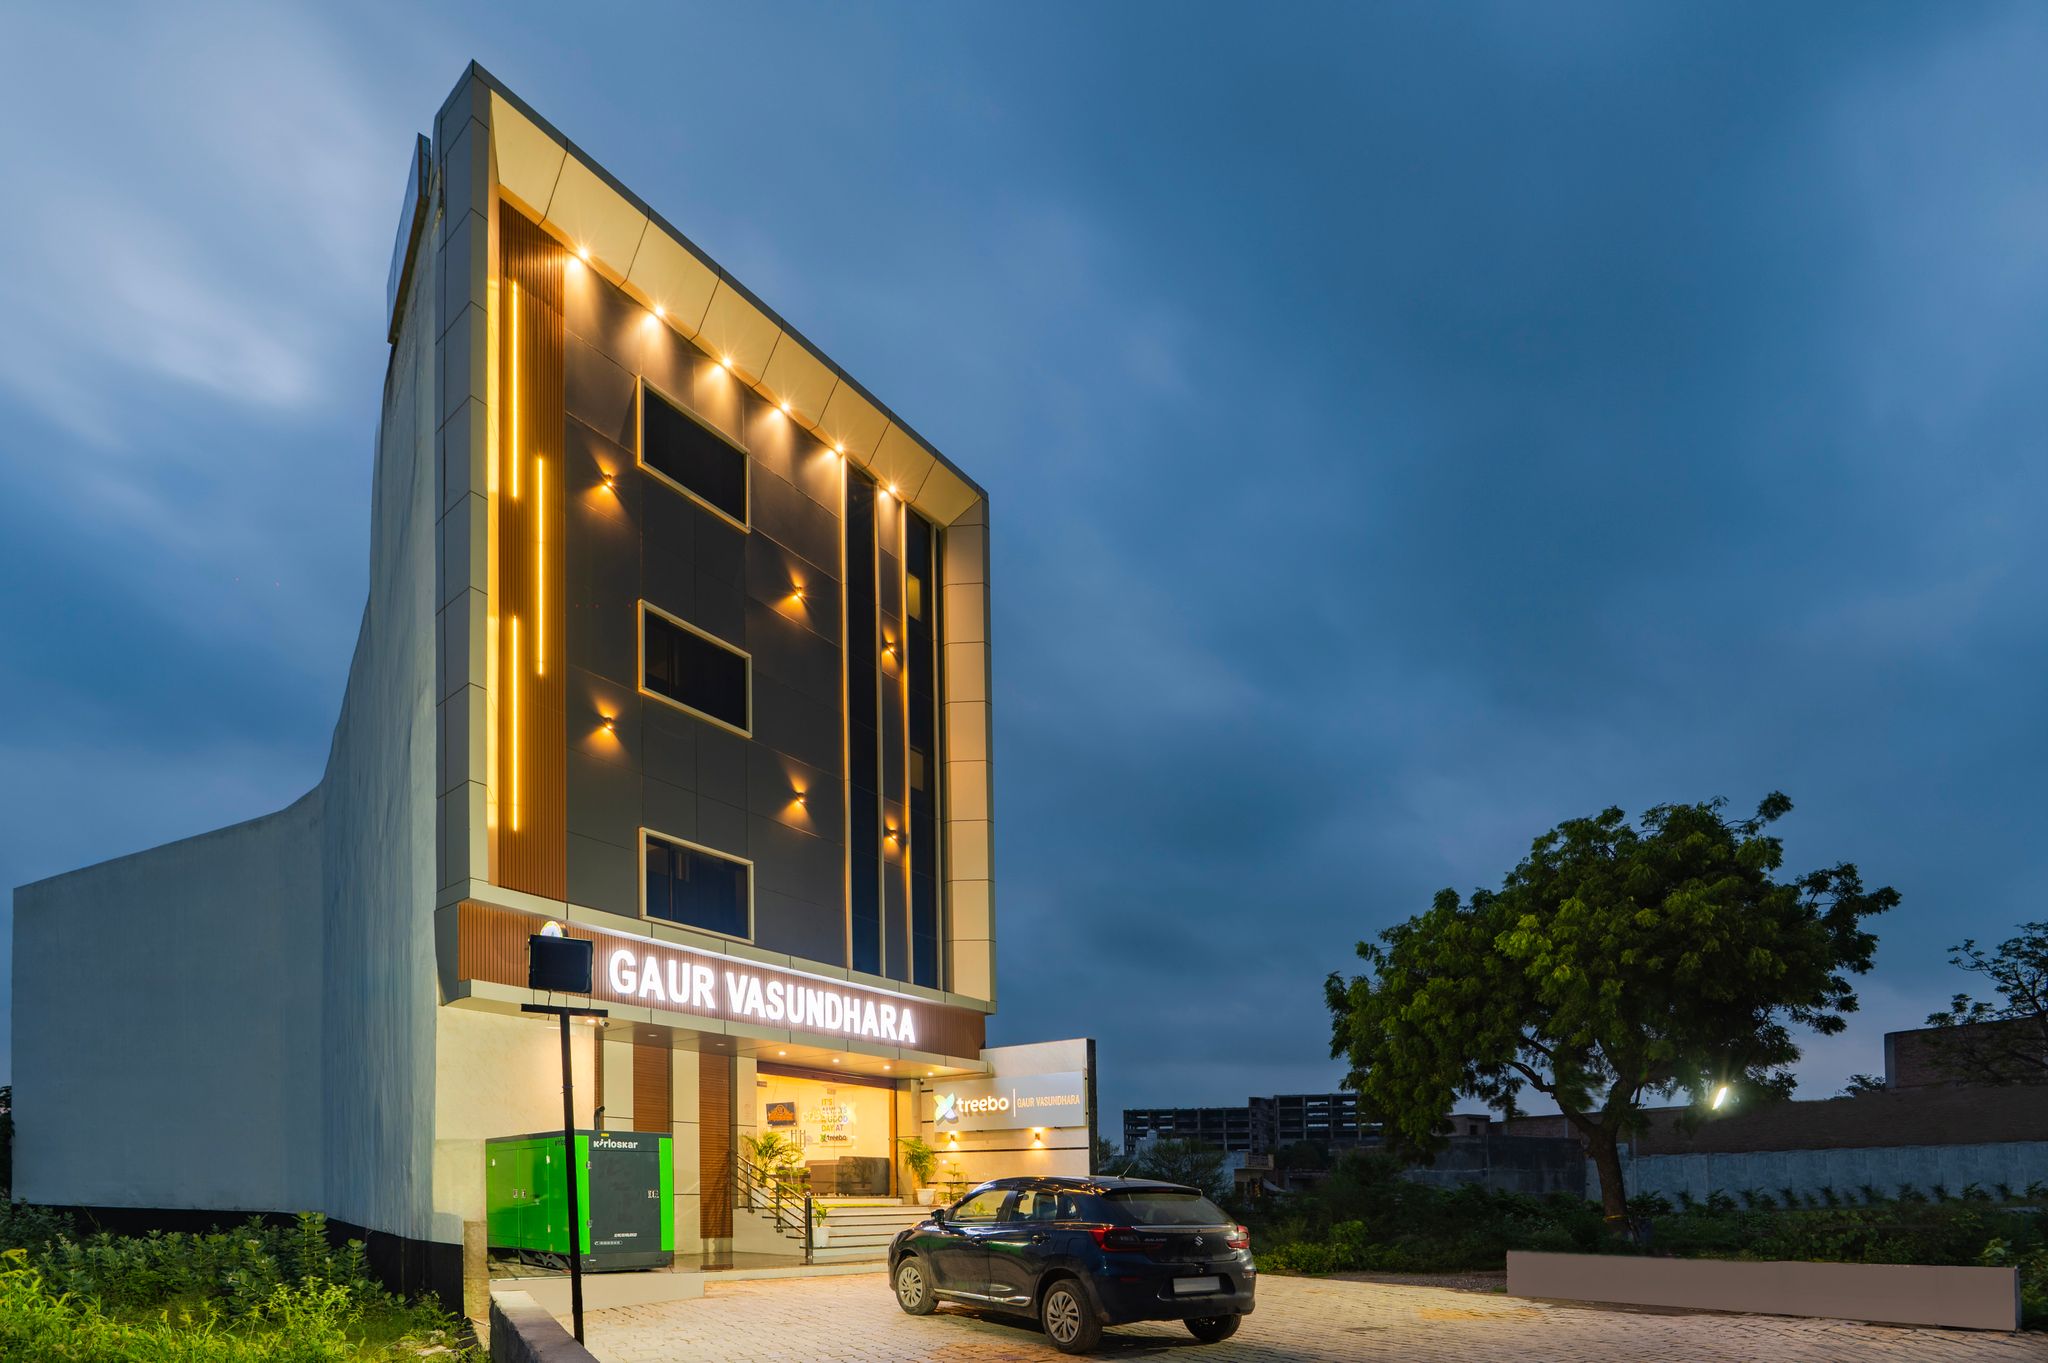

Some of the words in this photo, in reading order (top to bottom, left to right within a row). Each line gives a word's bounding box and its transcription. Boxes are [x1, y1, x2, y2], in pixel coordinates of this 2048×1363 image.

[608, 949, 716, 1009] GAUR
[725, 971, 917, 1044] VASUNDHARA
[956, 1096, 1009, 1112] treebo
[1017, 1097, 1035, 1108] GAUR
[1036, 1094, 1080, 1107] VASUNDHARA
